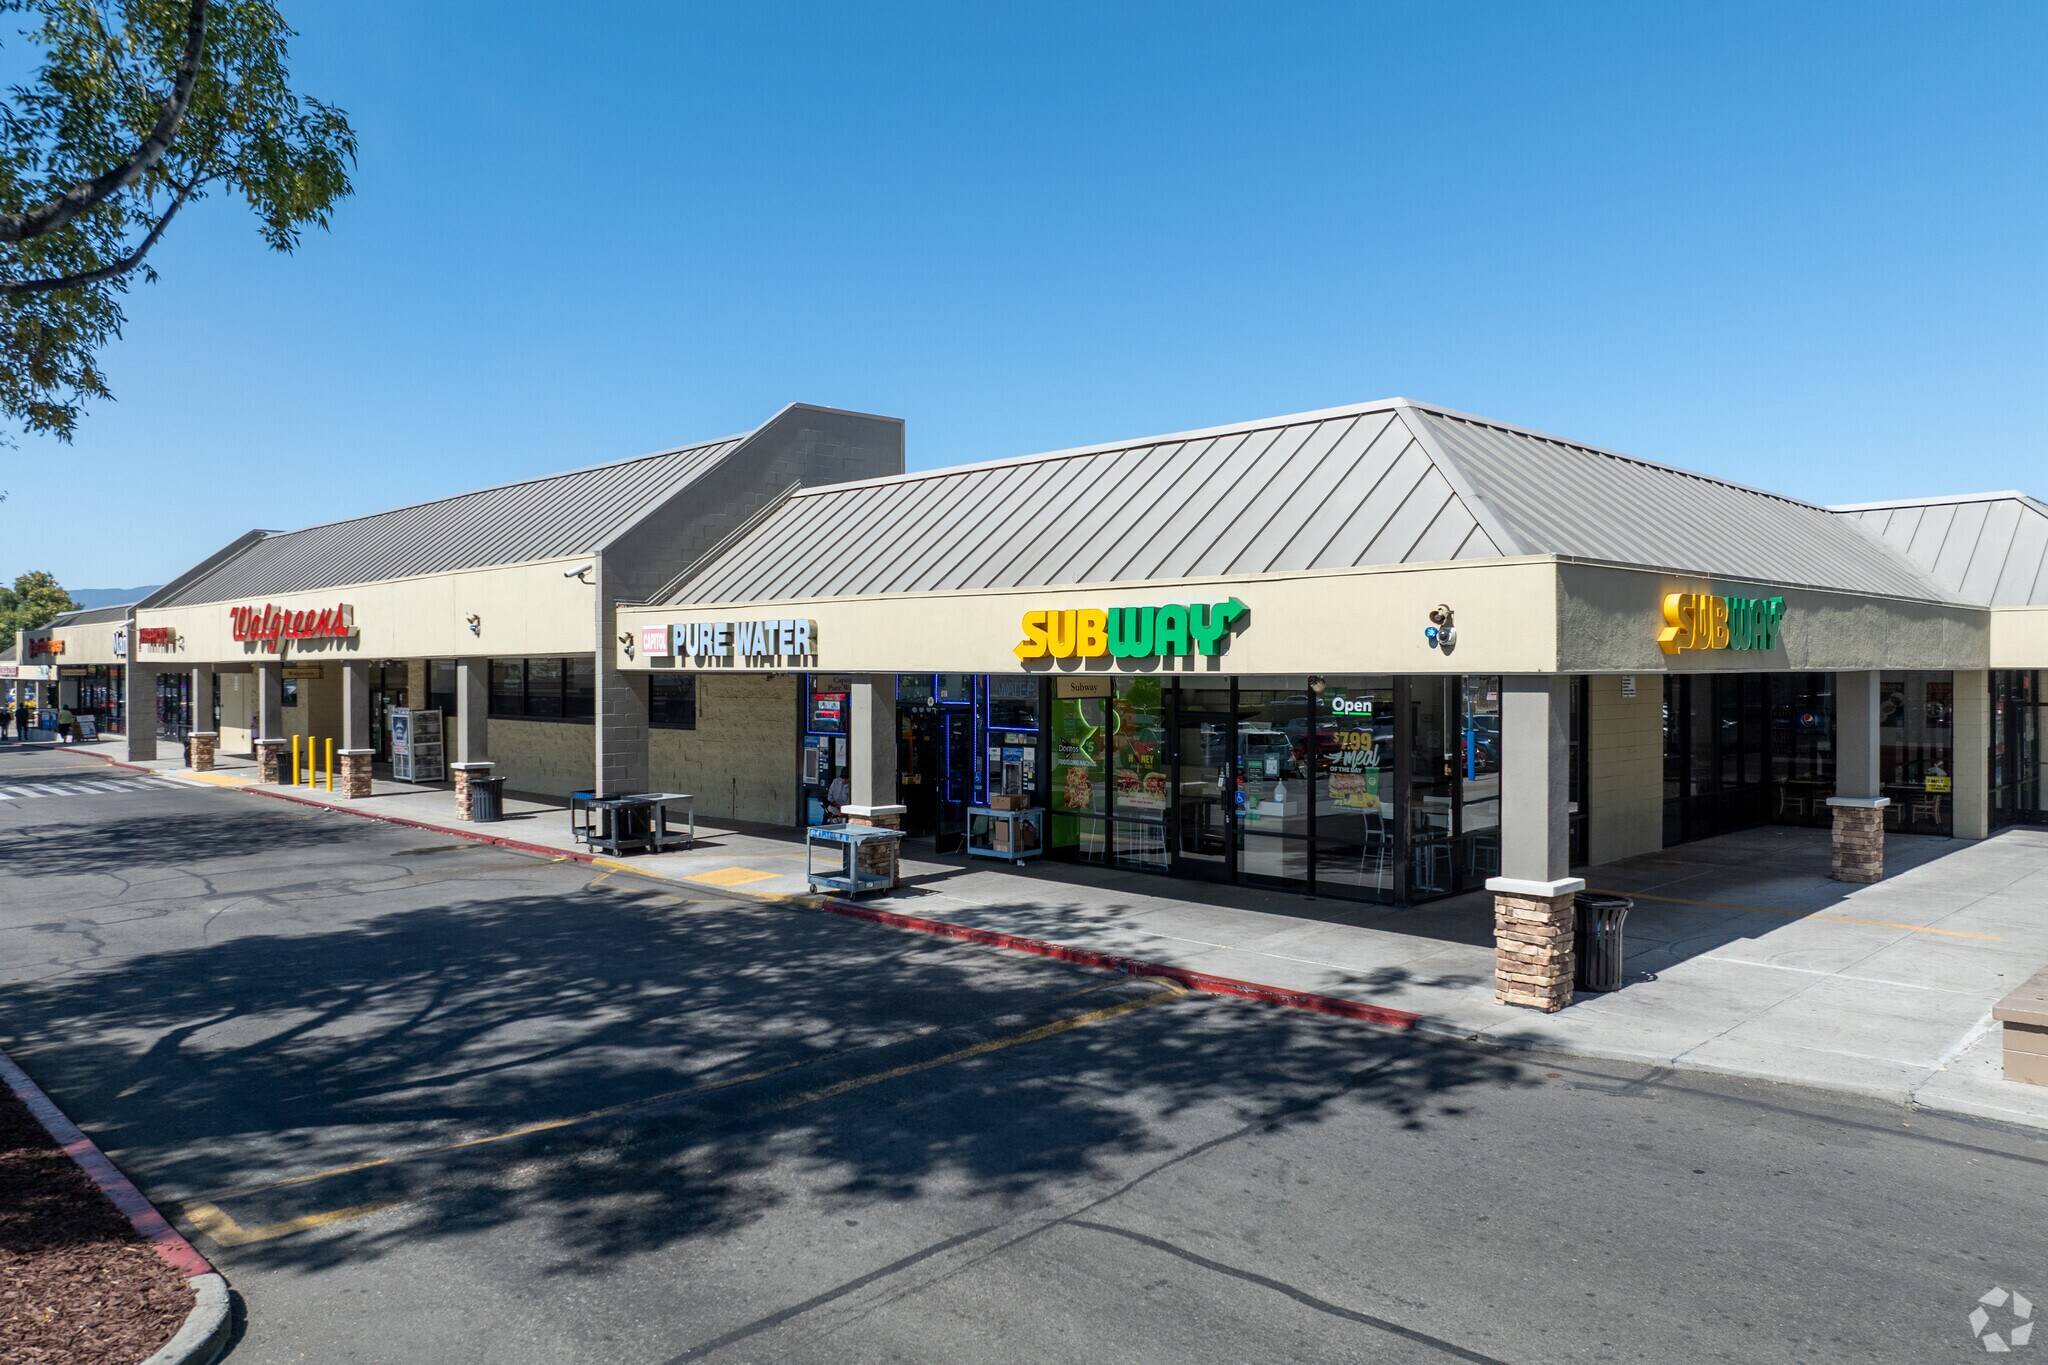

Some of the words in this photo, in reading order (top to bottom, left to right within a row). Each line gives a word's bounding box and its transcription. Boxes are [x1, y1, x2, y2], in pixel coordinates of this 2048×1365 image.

[230, 603, 350, 654] Walgreens
[1013, 597, 1251, 662] SUBWAY
[1657, 593, 1787, 654] SUBWAY
[643, 632, 667, 651] CAPITOL
[673, 622, 728, 657] PURE
[734, 619, 813, 656] WATER
[997, 681, 1037, 698] WATER
[1070, 682, 1098, 694] Subway
[1332, 697, 1372, 715] Open
[1058, 744, 1079, 753] Doritos
[1333, 731, 1372, 751] $7.99
[1343, 743, 1380, 768] meal
